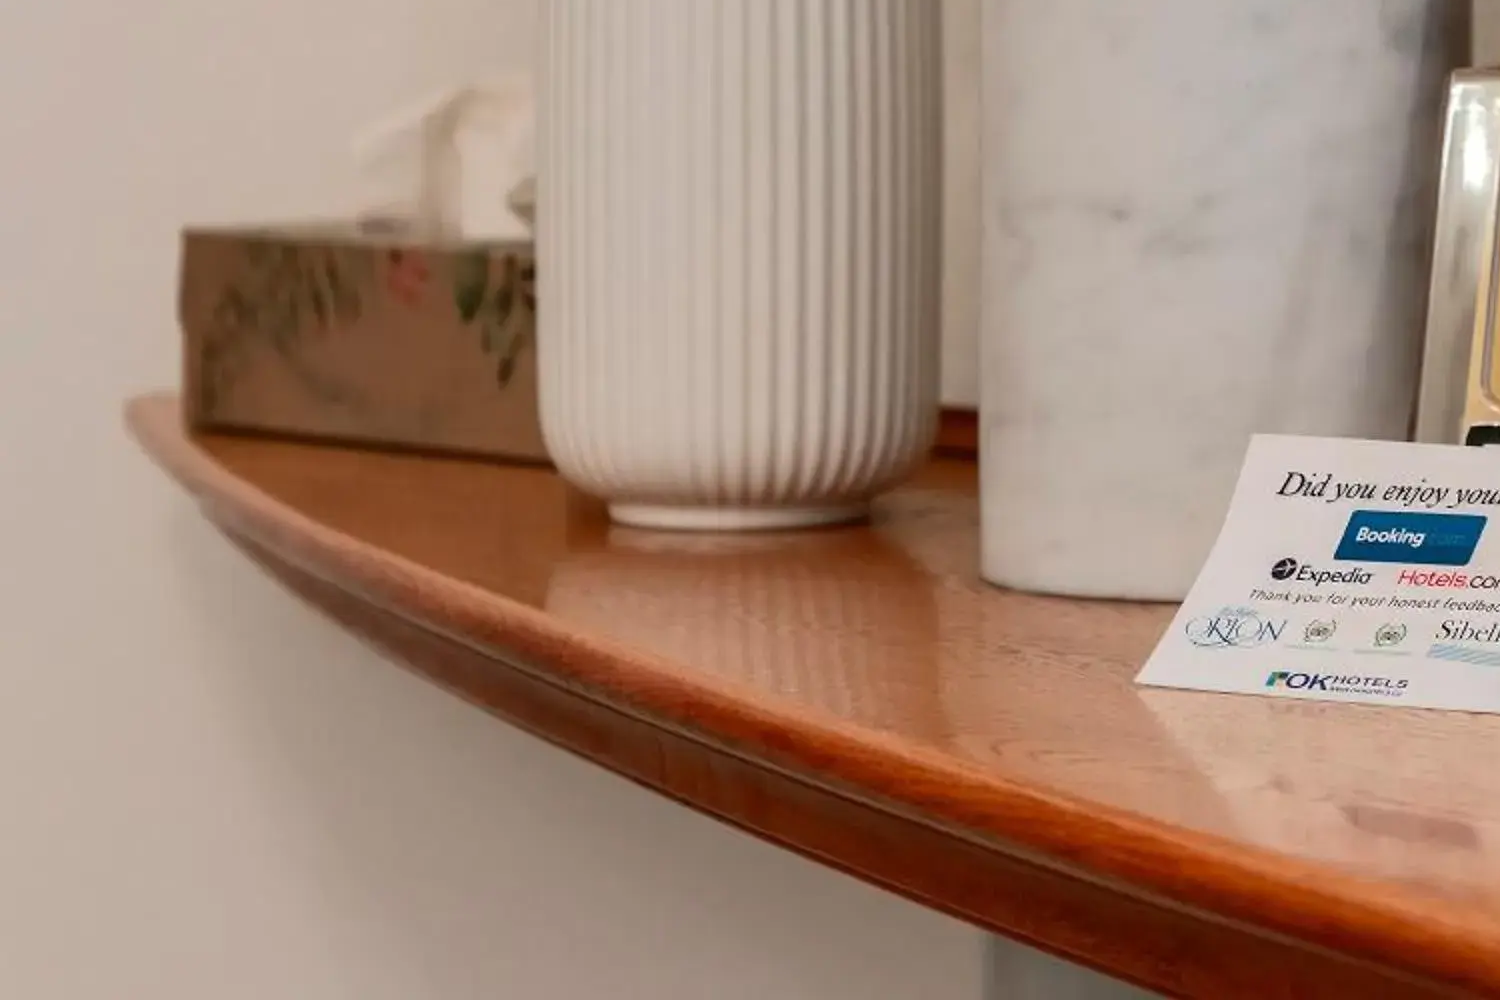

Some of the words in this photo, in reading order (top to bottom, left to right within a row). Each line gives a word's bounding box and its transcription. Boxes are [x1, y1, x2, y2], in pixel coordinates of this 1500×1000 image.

[1276, 471, 1333, 498] Did
[1326, 482, 1377, 503] you
[1382, 477, 1450, 508] enjoy
[1295, 564, 1376, 587] Expedia
[1249, 588, 1291, 603] Thank
[1292, 593, 1322, 605] you
[1325, 592, 1348, 606] for
[1350, 595, 1386, 609] your
[1387, 595, 1441, 610] honest
